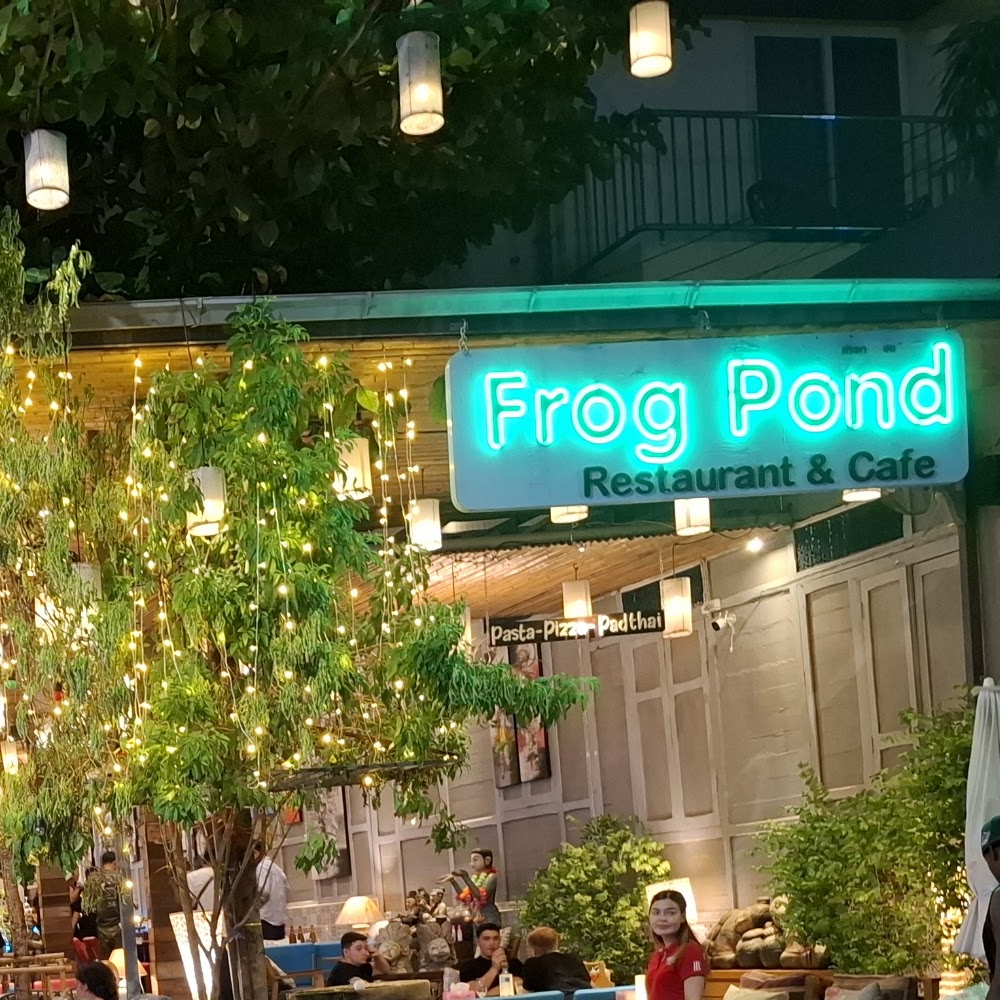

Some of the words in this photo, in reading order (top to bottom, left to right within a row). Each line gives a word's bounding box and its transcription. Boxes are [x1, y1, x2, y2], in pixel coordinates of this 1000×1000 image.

[485, 371, 687, 463] Frog
[728, 342, 954, 437] Pond
[582, 455, 795, 498] Restaurant
[806, 453, 835, 485] &
[848, 448, 937, 483] Cafe
